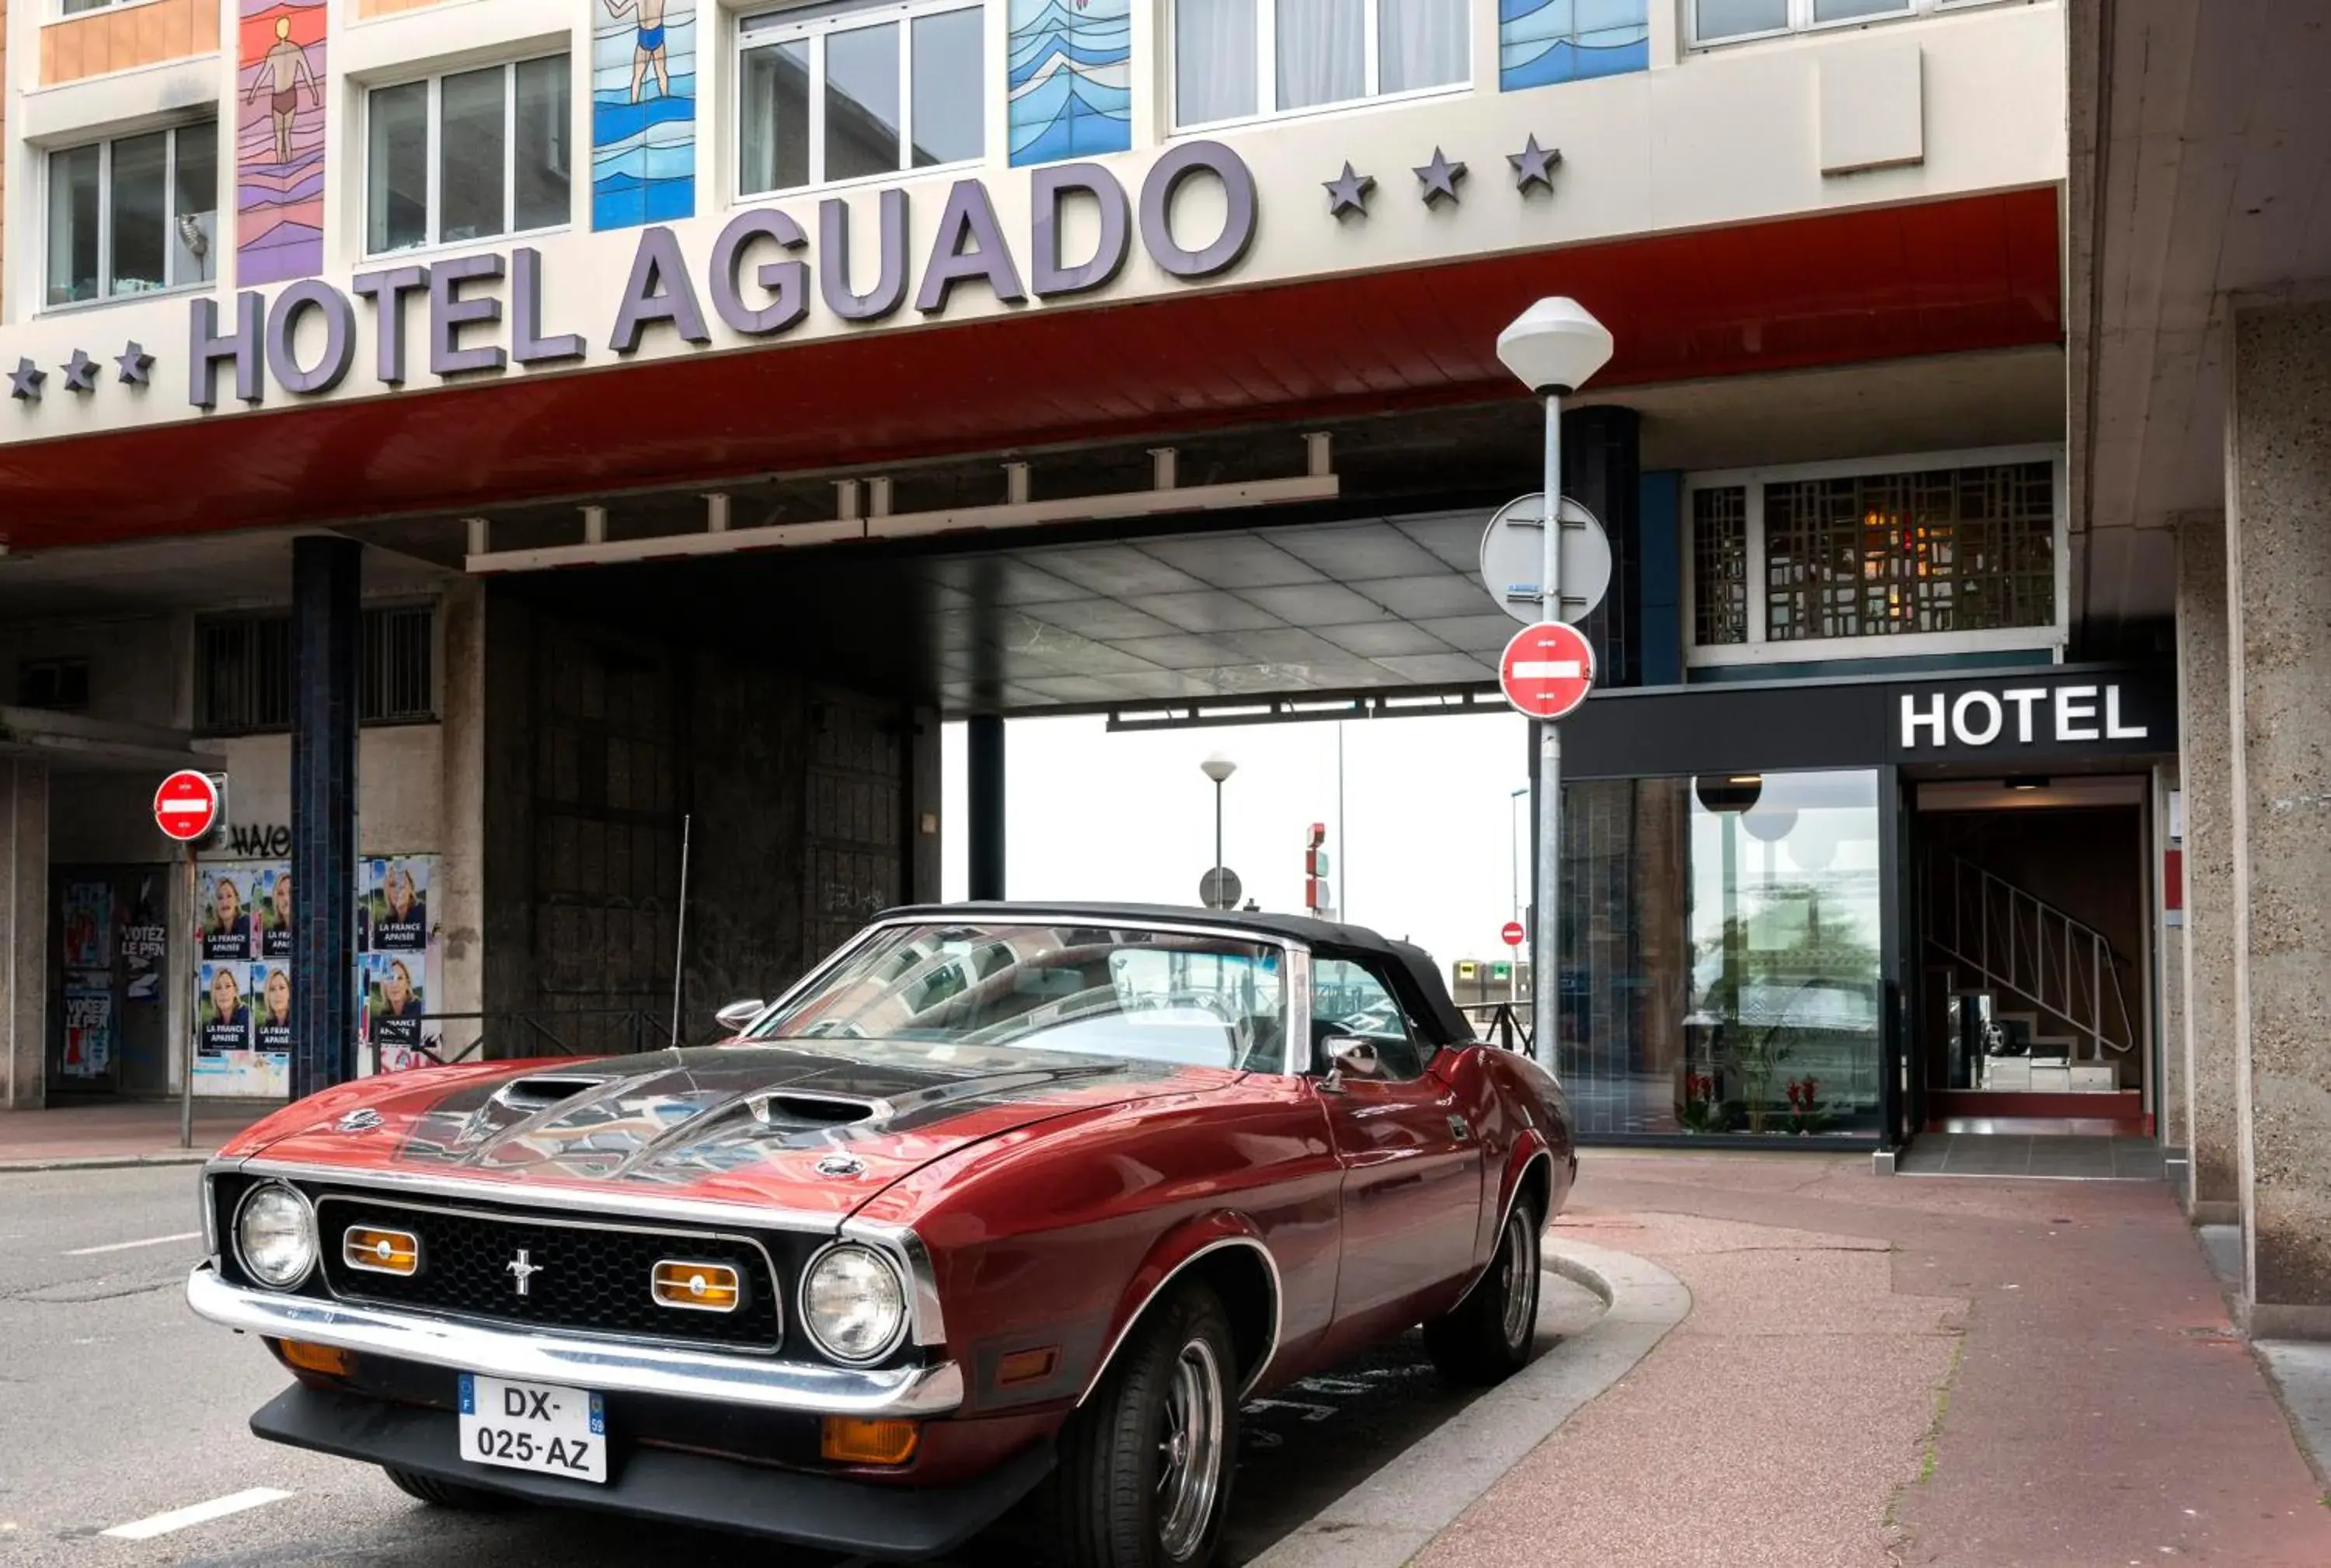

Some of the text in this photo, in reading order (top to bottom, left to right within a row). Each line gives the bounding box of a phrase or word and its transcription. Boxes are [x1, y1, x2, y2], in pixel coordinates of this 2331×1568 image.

[190, 140, 1259, 409] HOTEL AGUADO
[1901, 685, 2148, 747] HOTEL
[121, 925, 166, 941] VOTEZ
[378, 922, 421, 932] LA FRANCE
[218, 934, 246, 943] FRANCE
[122, 941, 138, 955] LE
[463, 1399, 471, 1411] F
[504, 1387, 560, 1421] DX-
[591, 1418, 605, 1433] 59
[477, 1427, 590, 1472] 025-AZ
